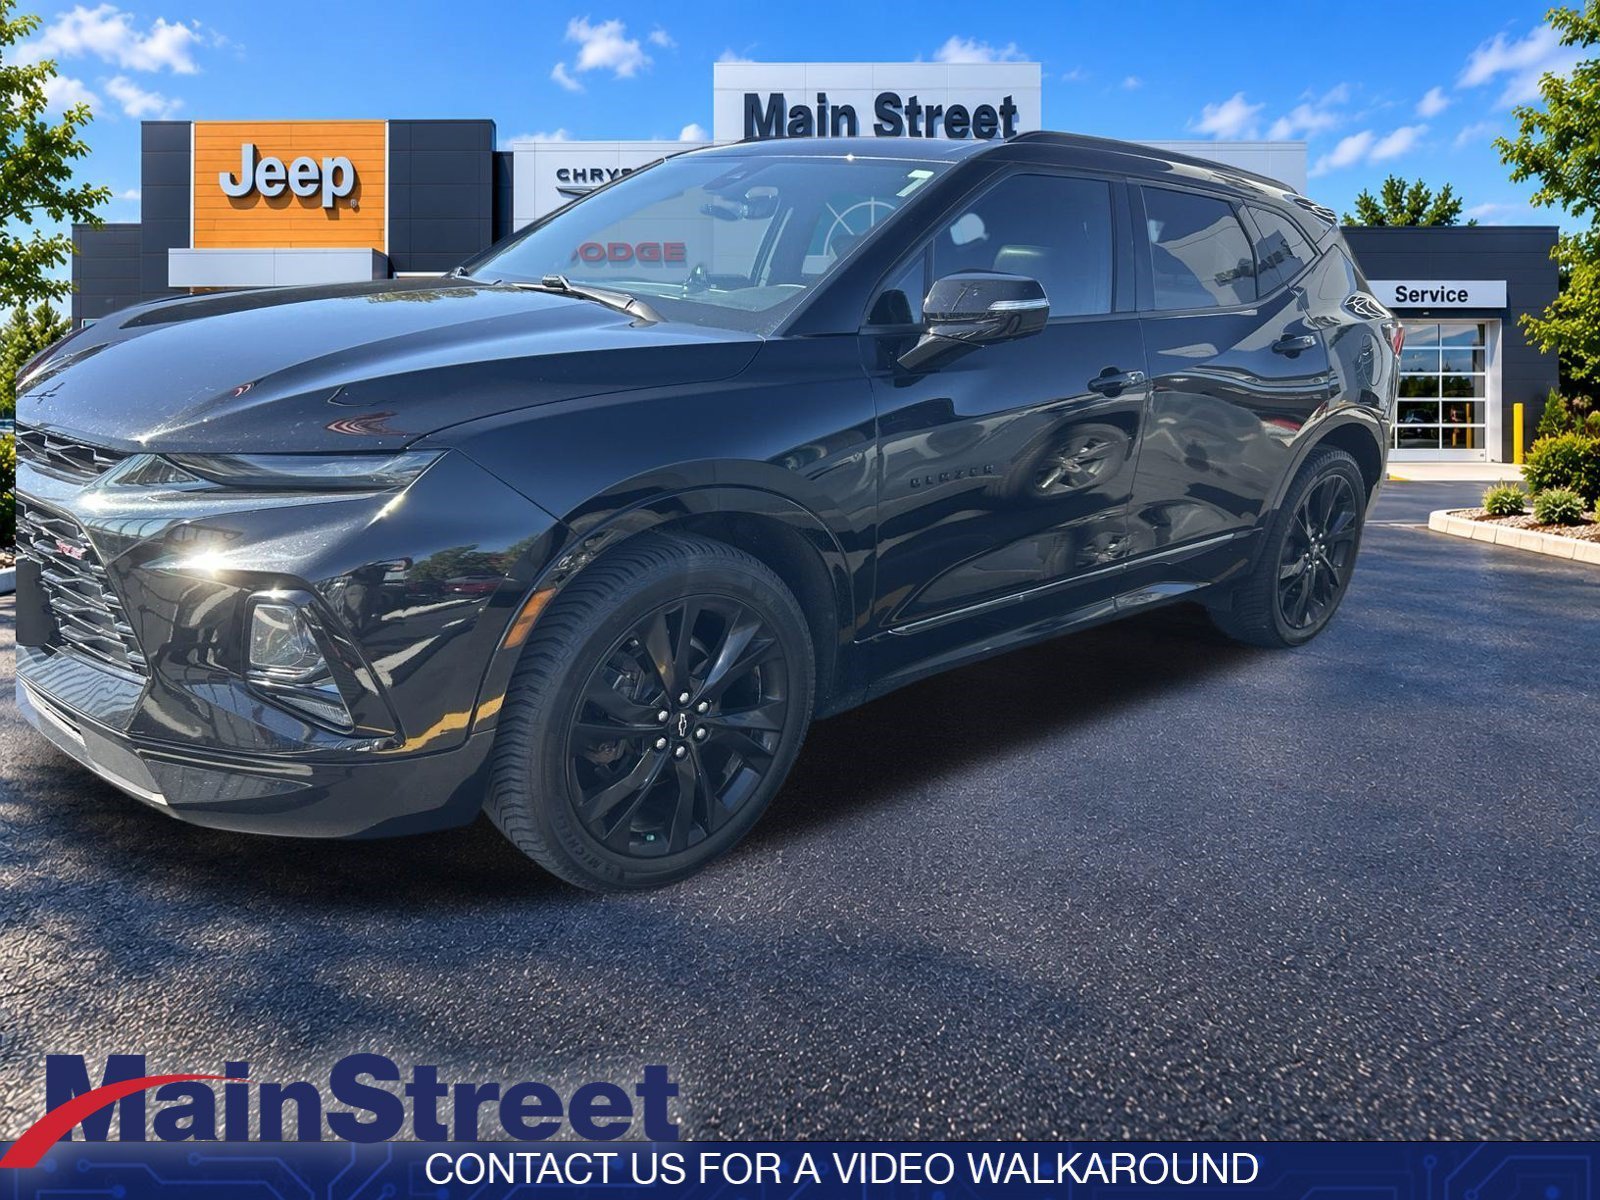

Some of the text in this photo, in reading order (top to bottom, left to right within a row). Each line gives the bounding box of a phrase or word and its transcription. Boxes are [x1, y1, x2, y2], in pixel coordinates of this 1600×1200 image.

[744, 91, 1018, 139] Main Street
[219, 143, 356, 209] Jeep
[570, 242, 687, 262] ODGE
[1395, 286, 1469, 303] Service
